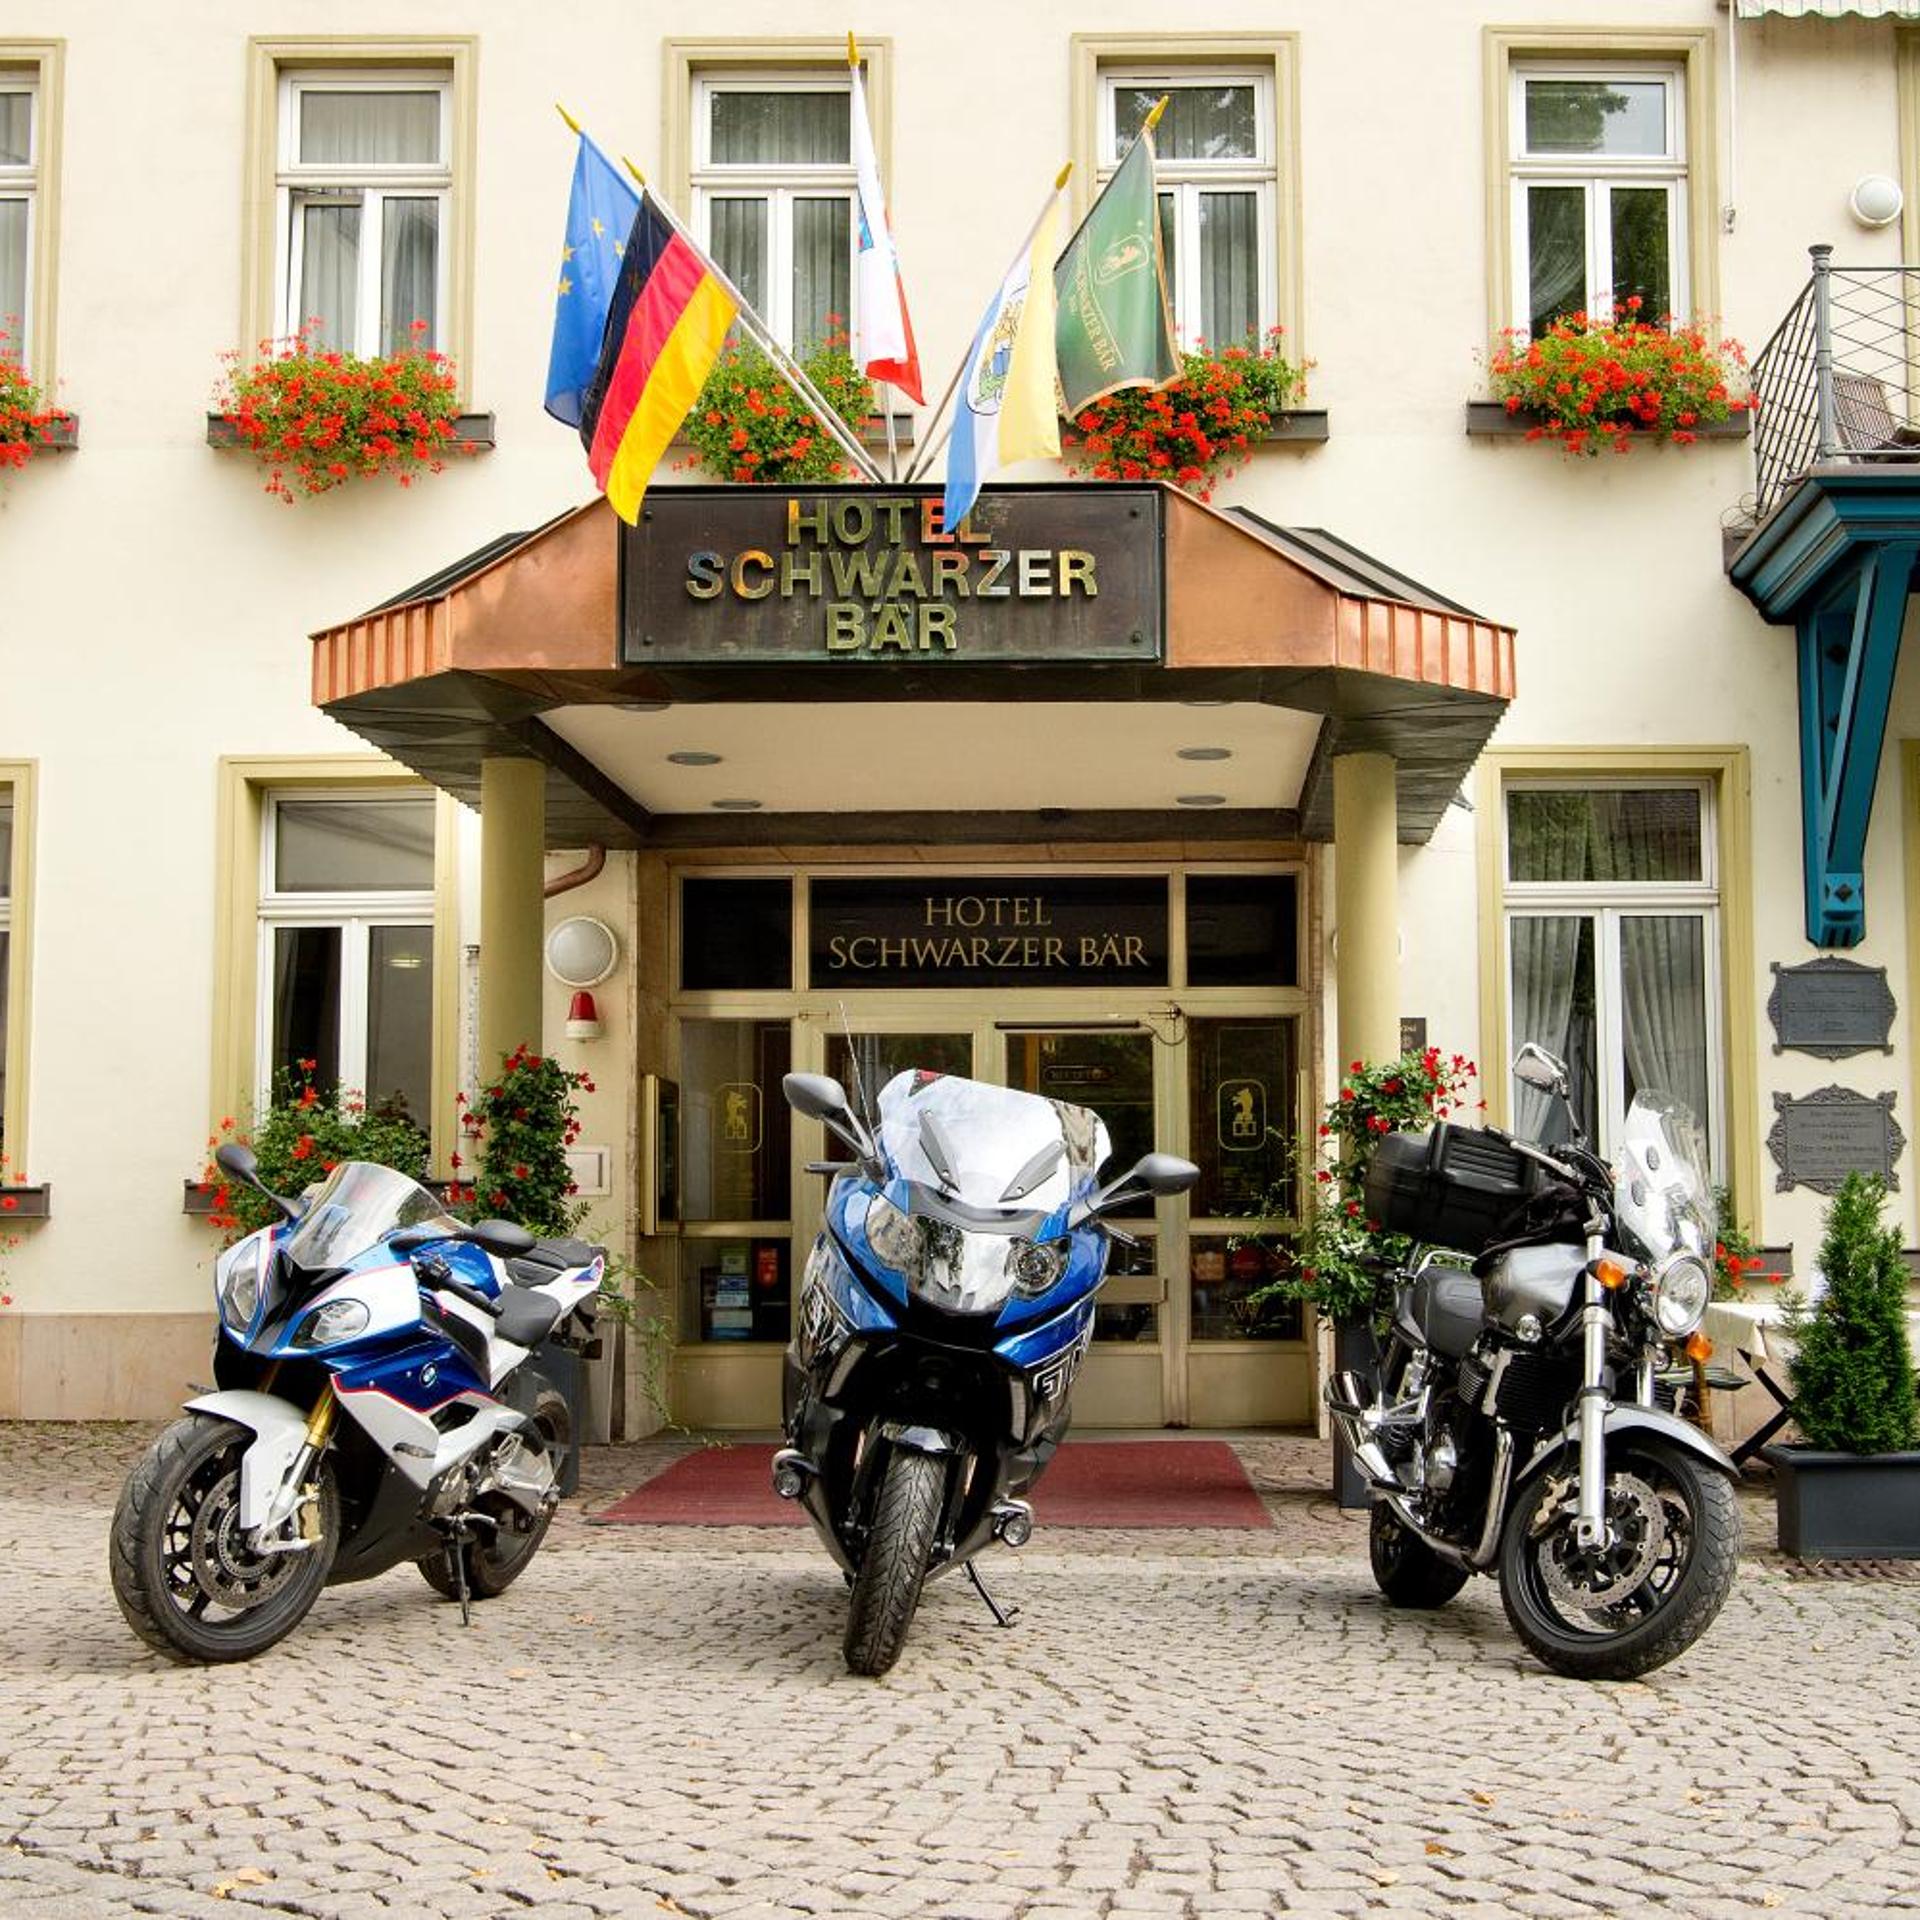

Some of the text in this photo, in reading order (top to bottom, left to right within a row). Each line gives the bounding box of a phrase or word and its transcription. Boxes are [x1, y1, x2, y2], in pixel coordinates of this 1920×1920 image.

[786, 498, 992, 544] HOTEL
[685, 549, 1099, 599] SCHWARZER
[825, 602, 959, 652] BÄR
[924, 896, 1052, 927] HOTEL
[829, 932, 1149, 969] SCHWARZER BÄR
